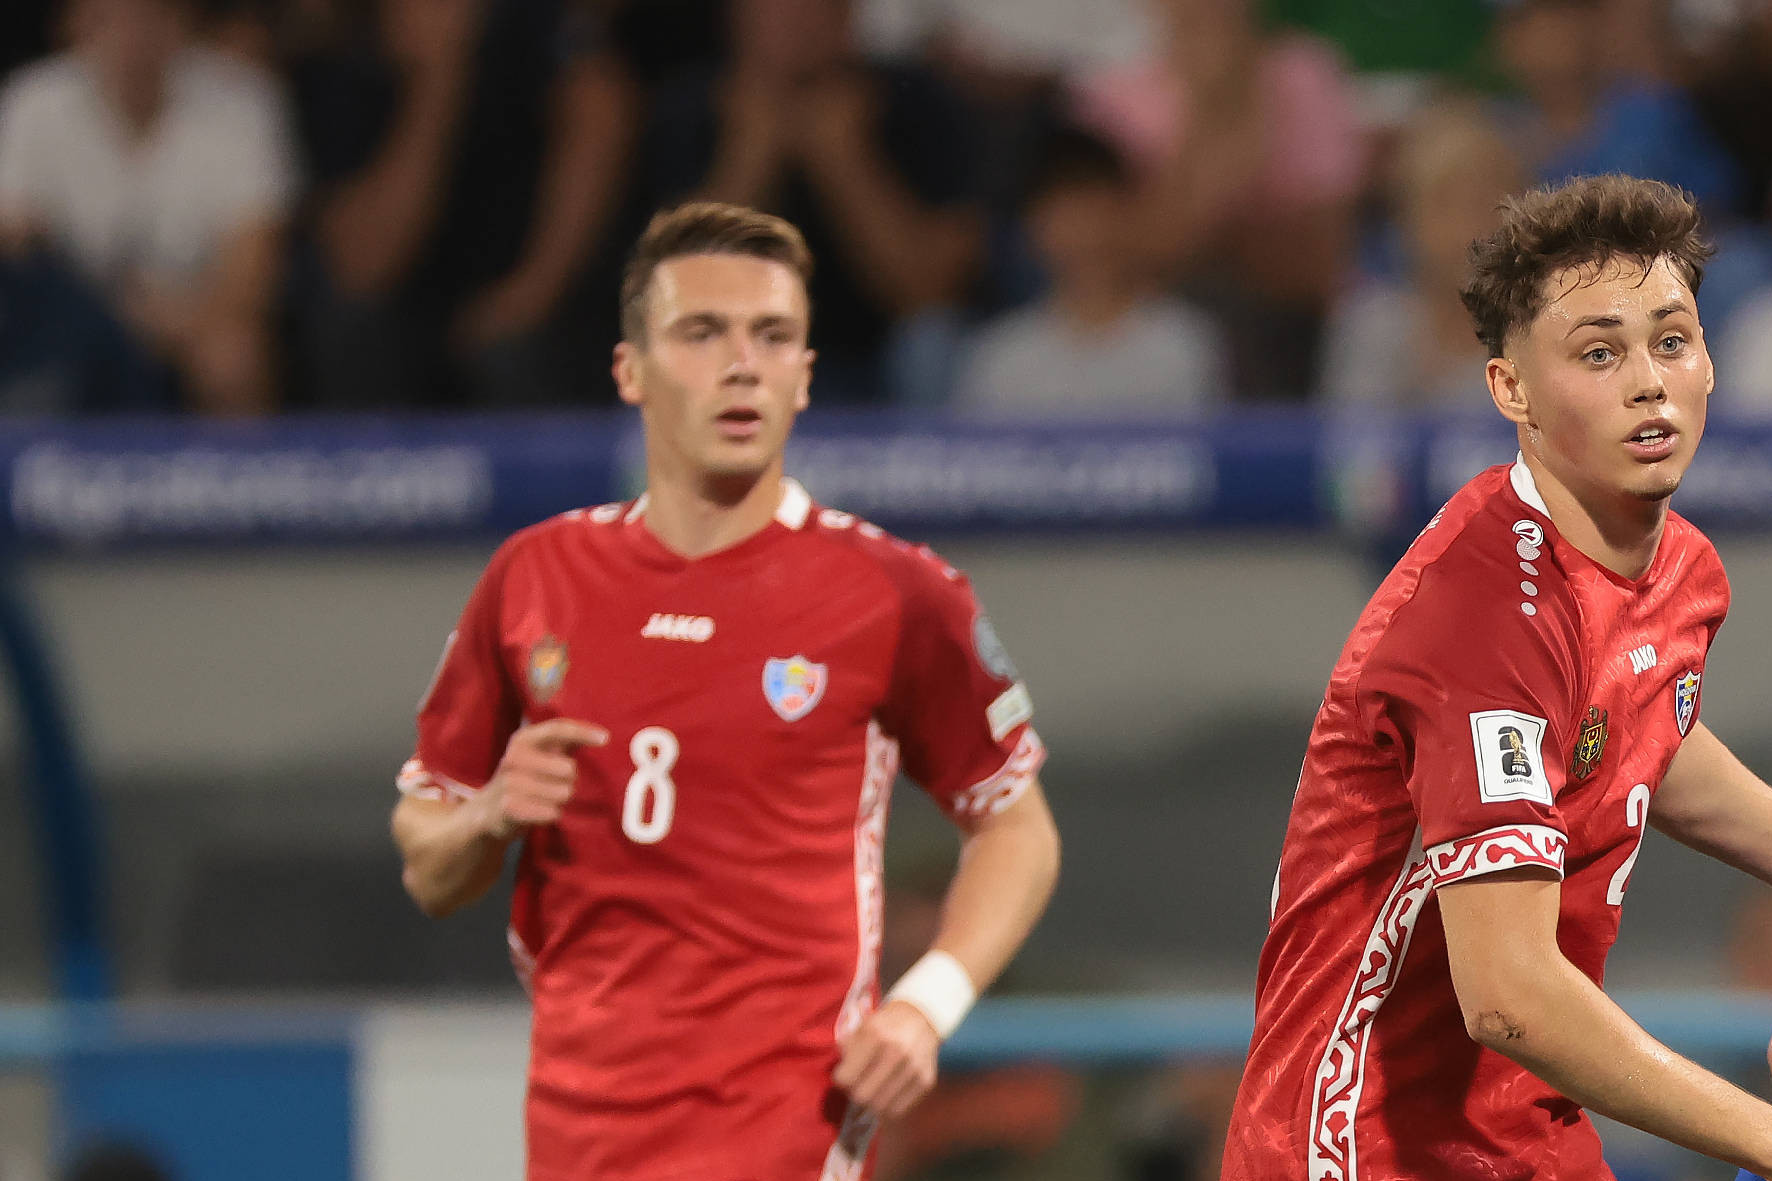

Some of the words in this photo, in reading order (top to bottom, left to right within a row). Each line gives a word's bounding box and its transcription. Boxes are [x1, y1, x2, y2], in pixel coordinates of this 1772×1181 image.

[641, 613, 716, 642] JAKO
[1628, 643, 1658, 675] JAKO
[621, 725, 680, 844] 8
